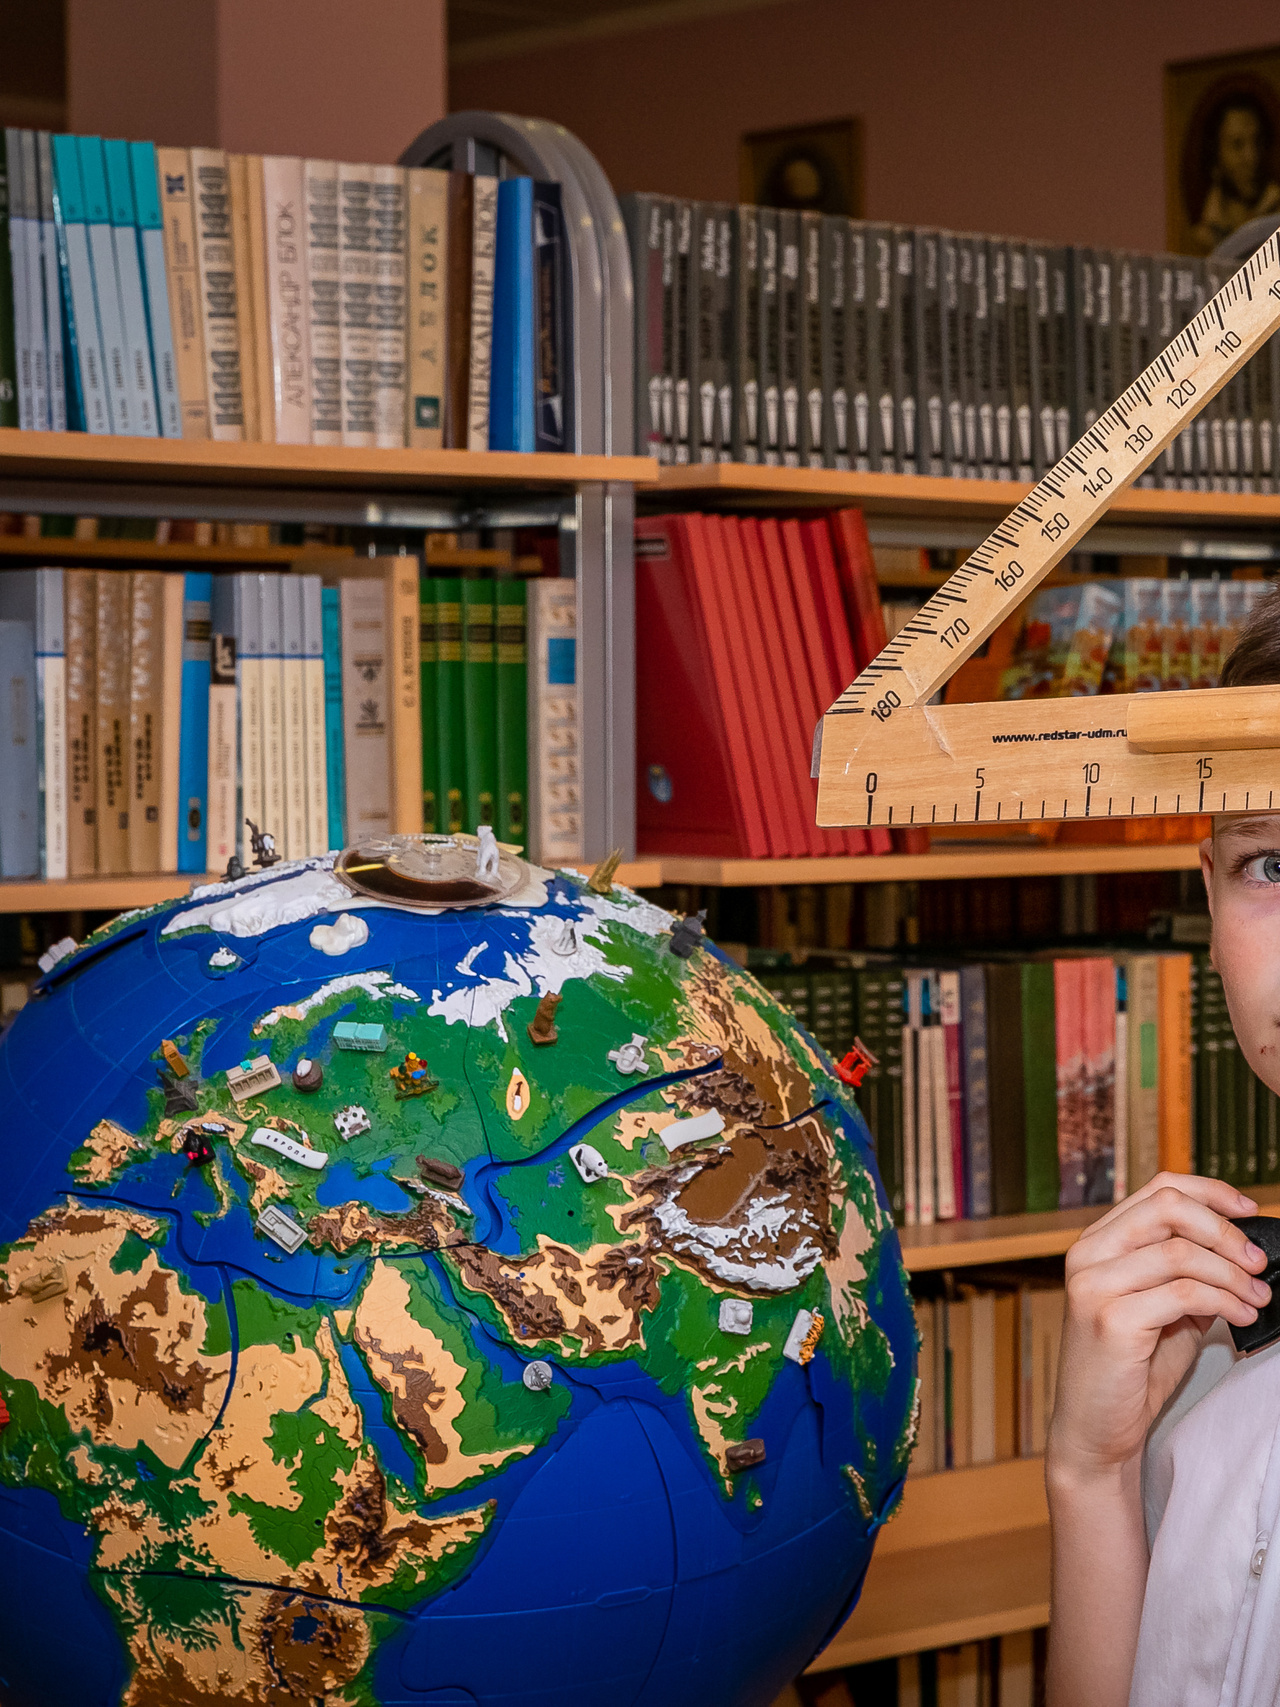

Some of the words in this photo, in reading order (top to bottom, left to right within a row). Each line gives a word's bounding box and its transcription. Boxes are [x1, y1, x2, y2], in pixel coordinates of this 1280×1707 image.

[276, 199, 298, 265] БЛОК
[277, 269, 306, 408] АЛЕКСАНДР
[1214, 331, 1242, 359] 110
[1166, 378, 1197, 410] 120
[1124, 424, 1154, 455] 130
[1082, 466, 1113, 499] 140
[1040, 512, 1070, 543] 150
[993, 560, 1025, 592] 160
[940, 617, 970, 649] 170
[870, 690, 902, 723] 180
[865, 772, 878, 794] 0
[975, 767, 986, 789] 5
[1082, 762, 1101, 784] 10
[1195, 757, 1213, 779] 15
[265, 1134, 307, 1159] ЕВРОПА
